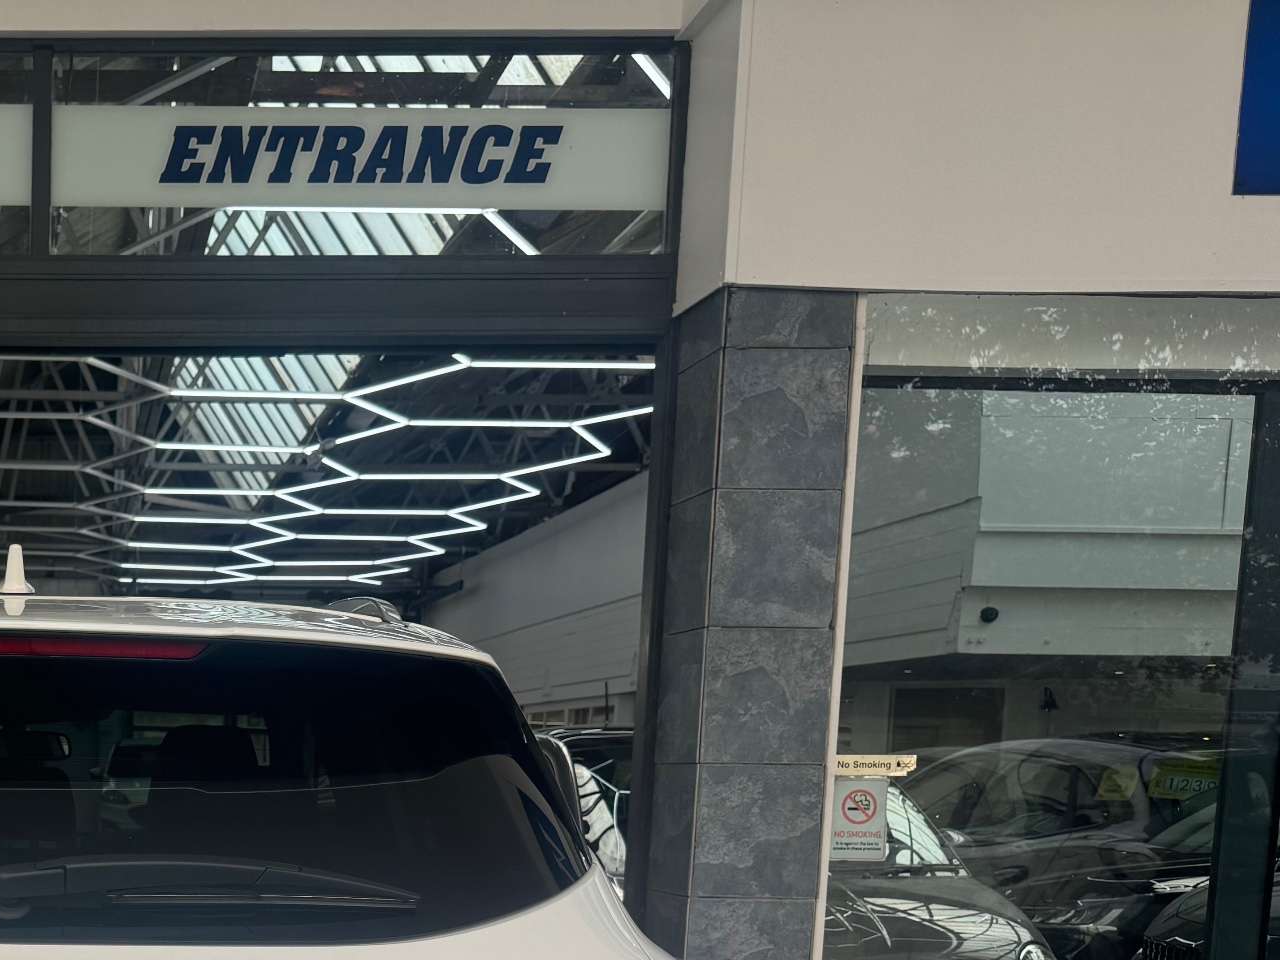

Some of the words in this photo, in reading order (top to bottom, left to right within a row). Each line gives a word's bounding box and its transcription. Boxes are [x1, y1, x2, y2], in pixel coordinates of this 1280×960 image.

[159, 125, 564, 186] ENTRANCE
[837, 760, 850, 769] No
[853, 760, 892, 770] Smoking
[834, 830, 846, 839] NO
[847, 830, 881, 839] SMOKING
